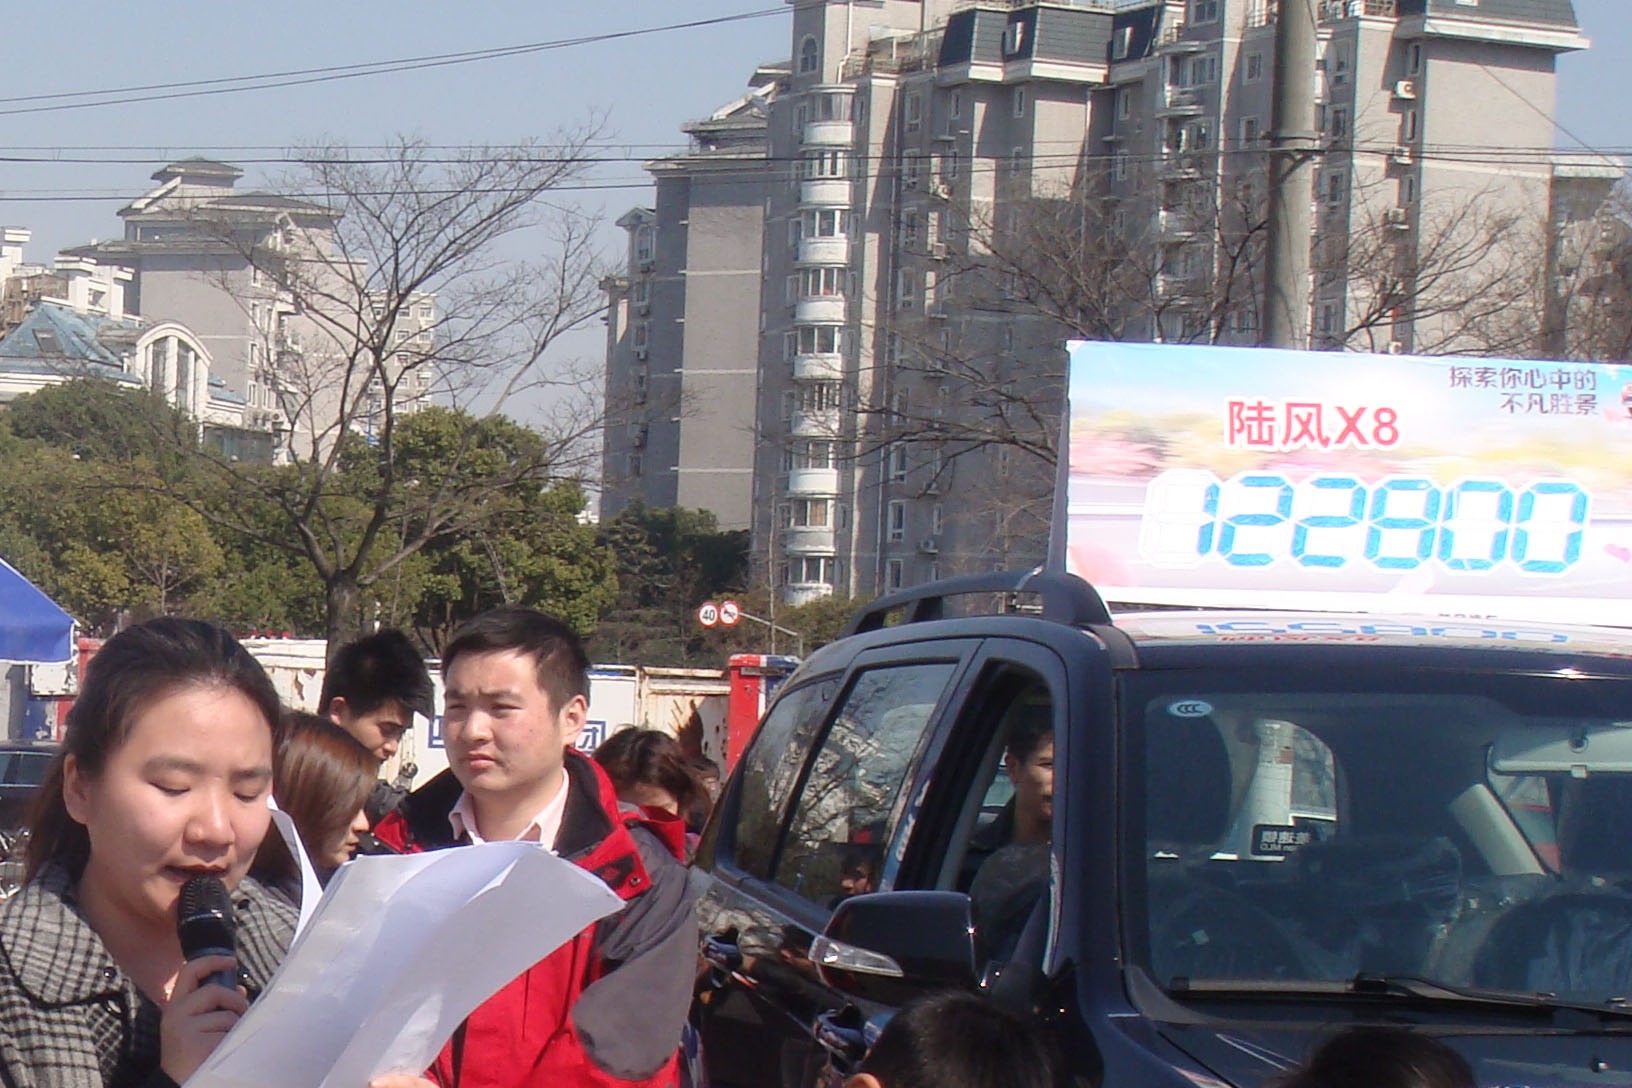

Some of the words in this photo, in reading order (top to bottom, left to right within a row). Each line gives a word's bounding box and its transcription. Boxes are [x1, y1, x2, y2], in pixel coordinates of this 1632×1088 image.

[1448, 366, 1597, 391] 探索你心中的
[1499, 391, 1598, 415] 不凡胜景
[1227, 400, 1400, 448] 陆风X8
[1197, 475, 1589, 574] 122800
[702, 609, 716, 621] 40
